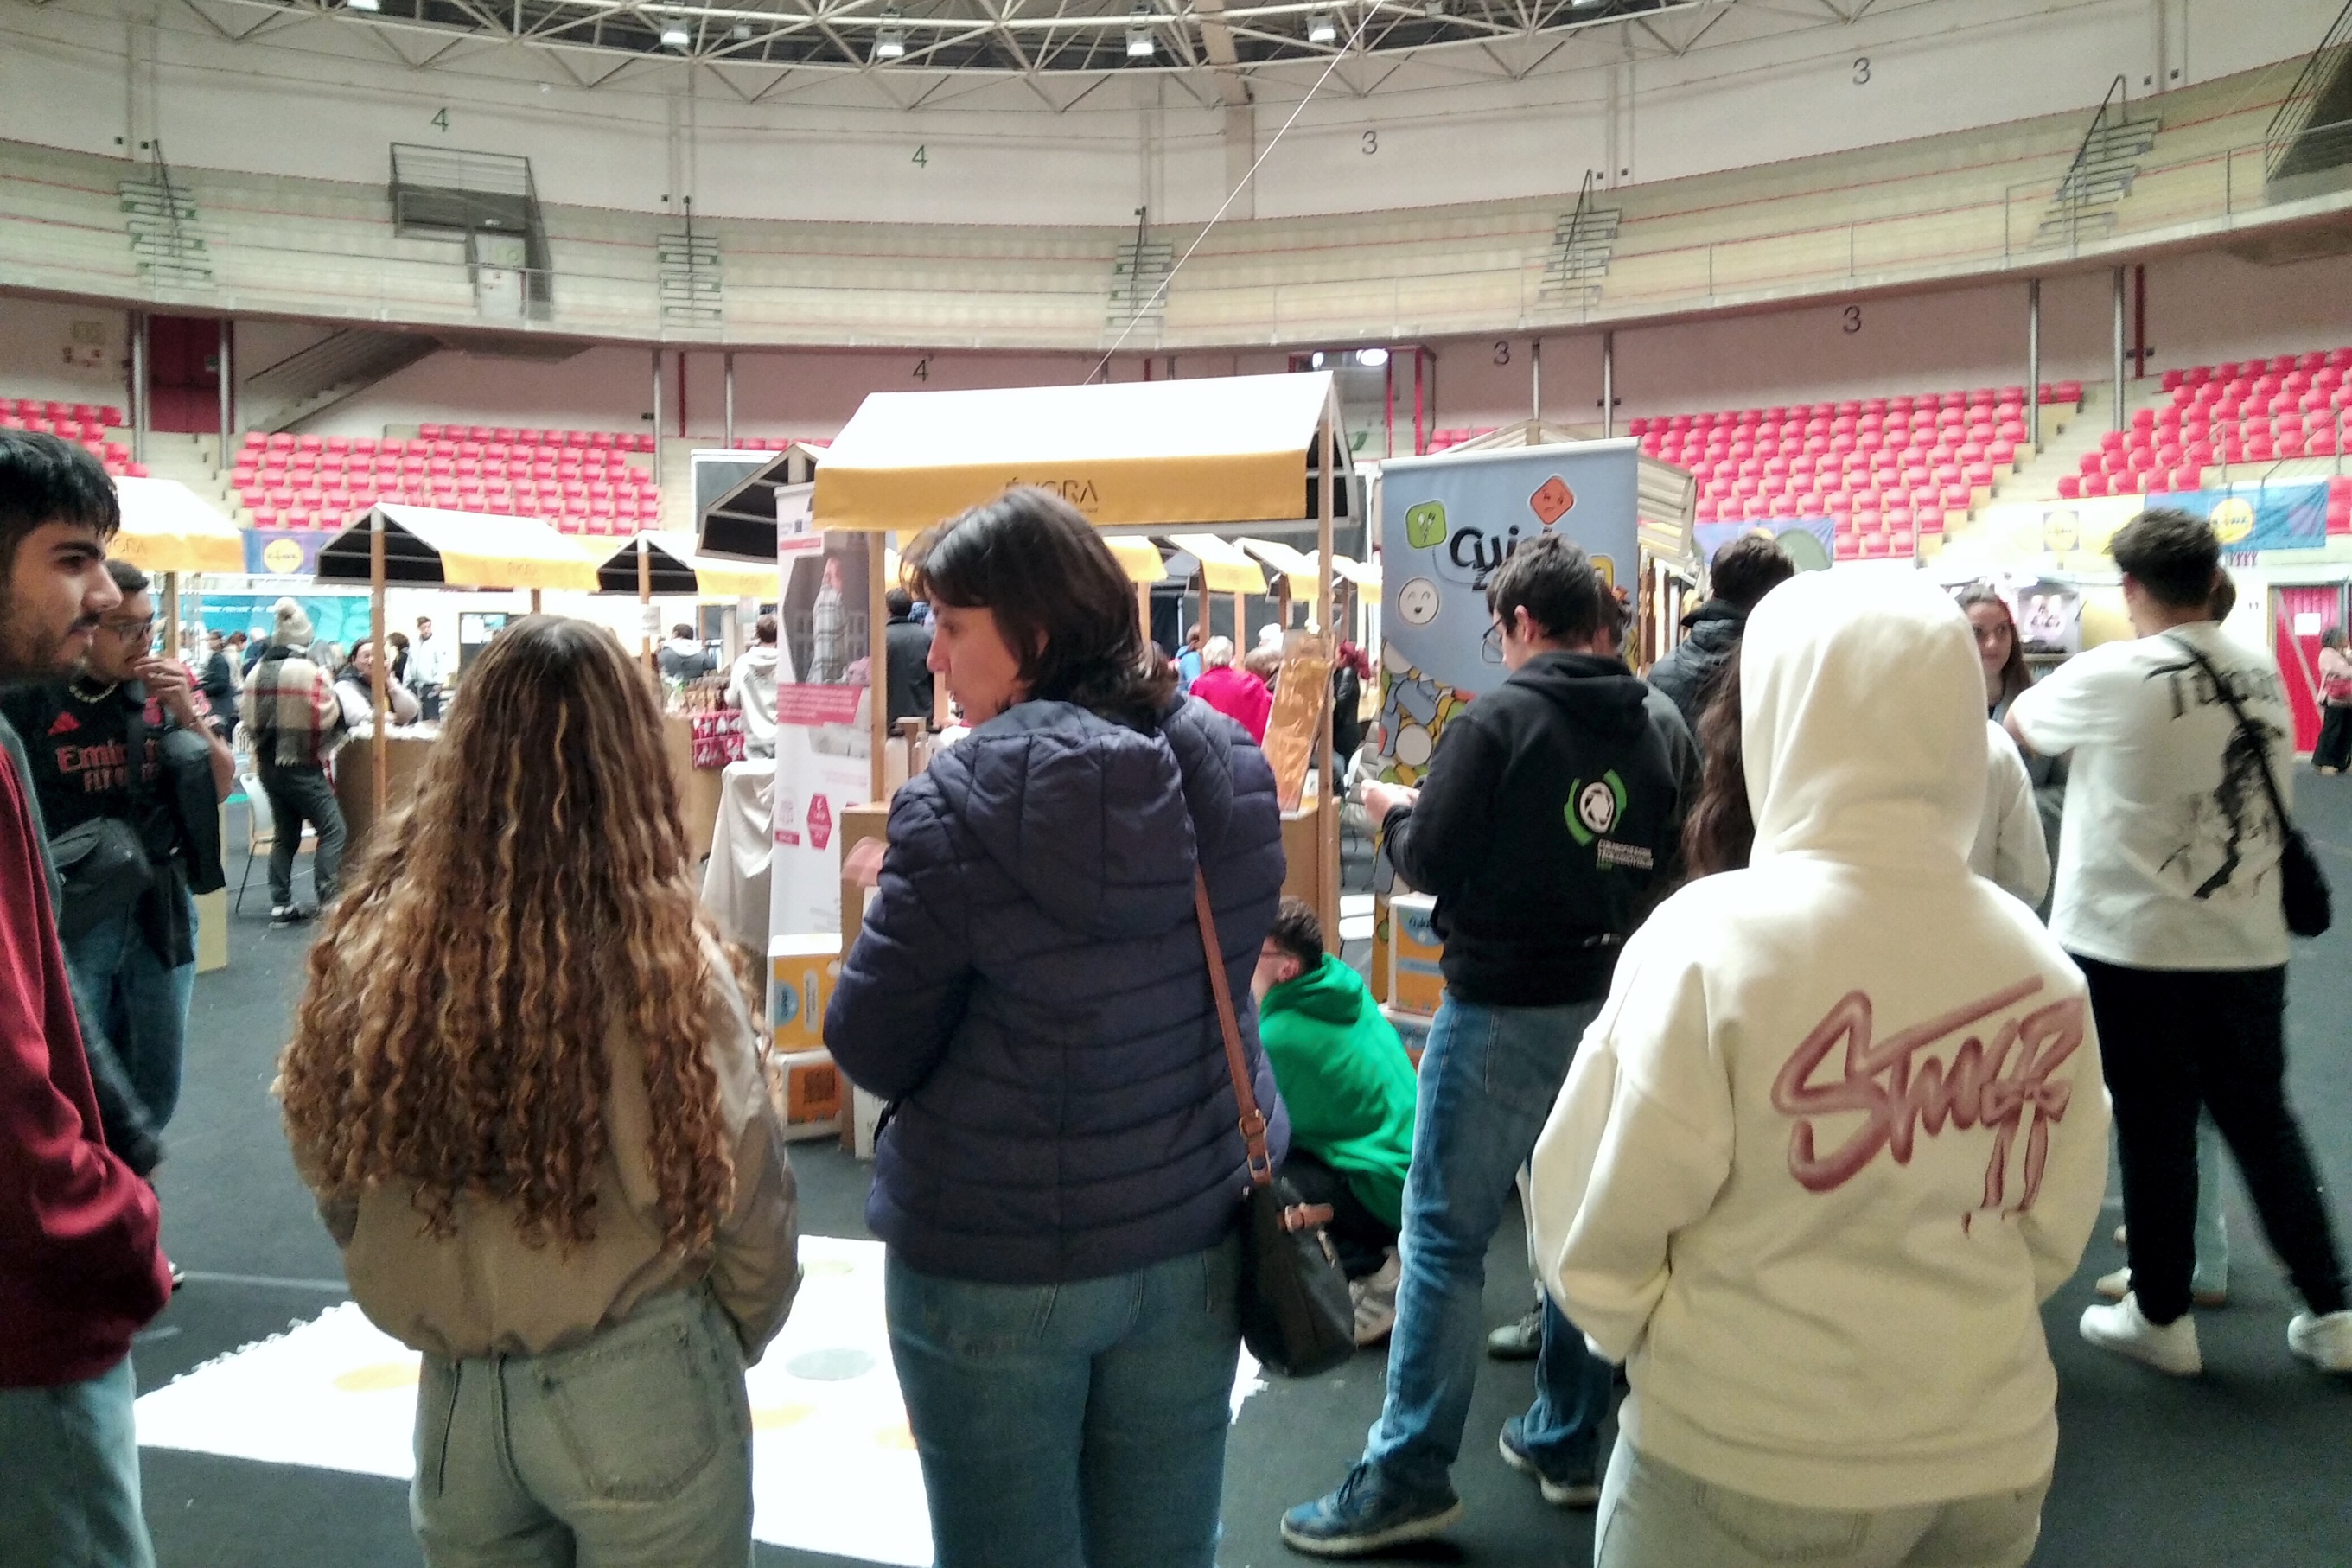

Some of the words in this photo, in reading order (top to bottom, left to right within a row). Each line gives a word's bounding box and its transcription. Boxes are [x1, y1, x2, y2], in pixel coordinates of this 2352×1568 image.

[1852, 56, 1871, 85] 3
[430, 106, 449, 133] 4
[1361, 129, 1378, 155] 3
[911, 143, 928, 169] 4
[1843, 305, 1862, 334] 3
[1494, 340, 1510, 366] 3
[912, 358, 929, 382] 4
